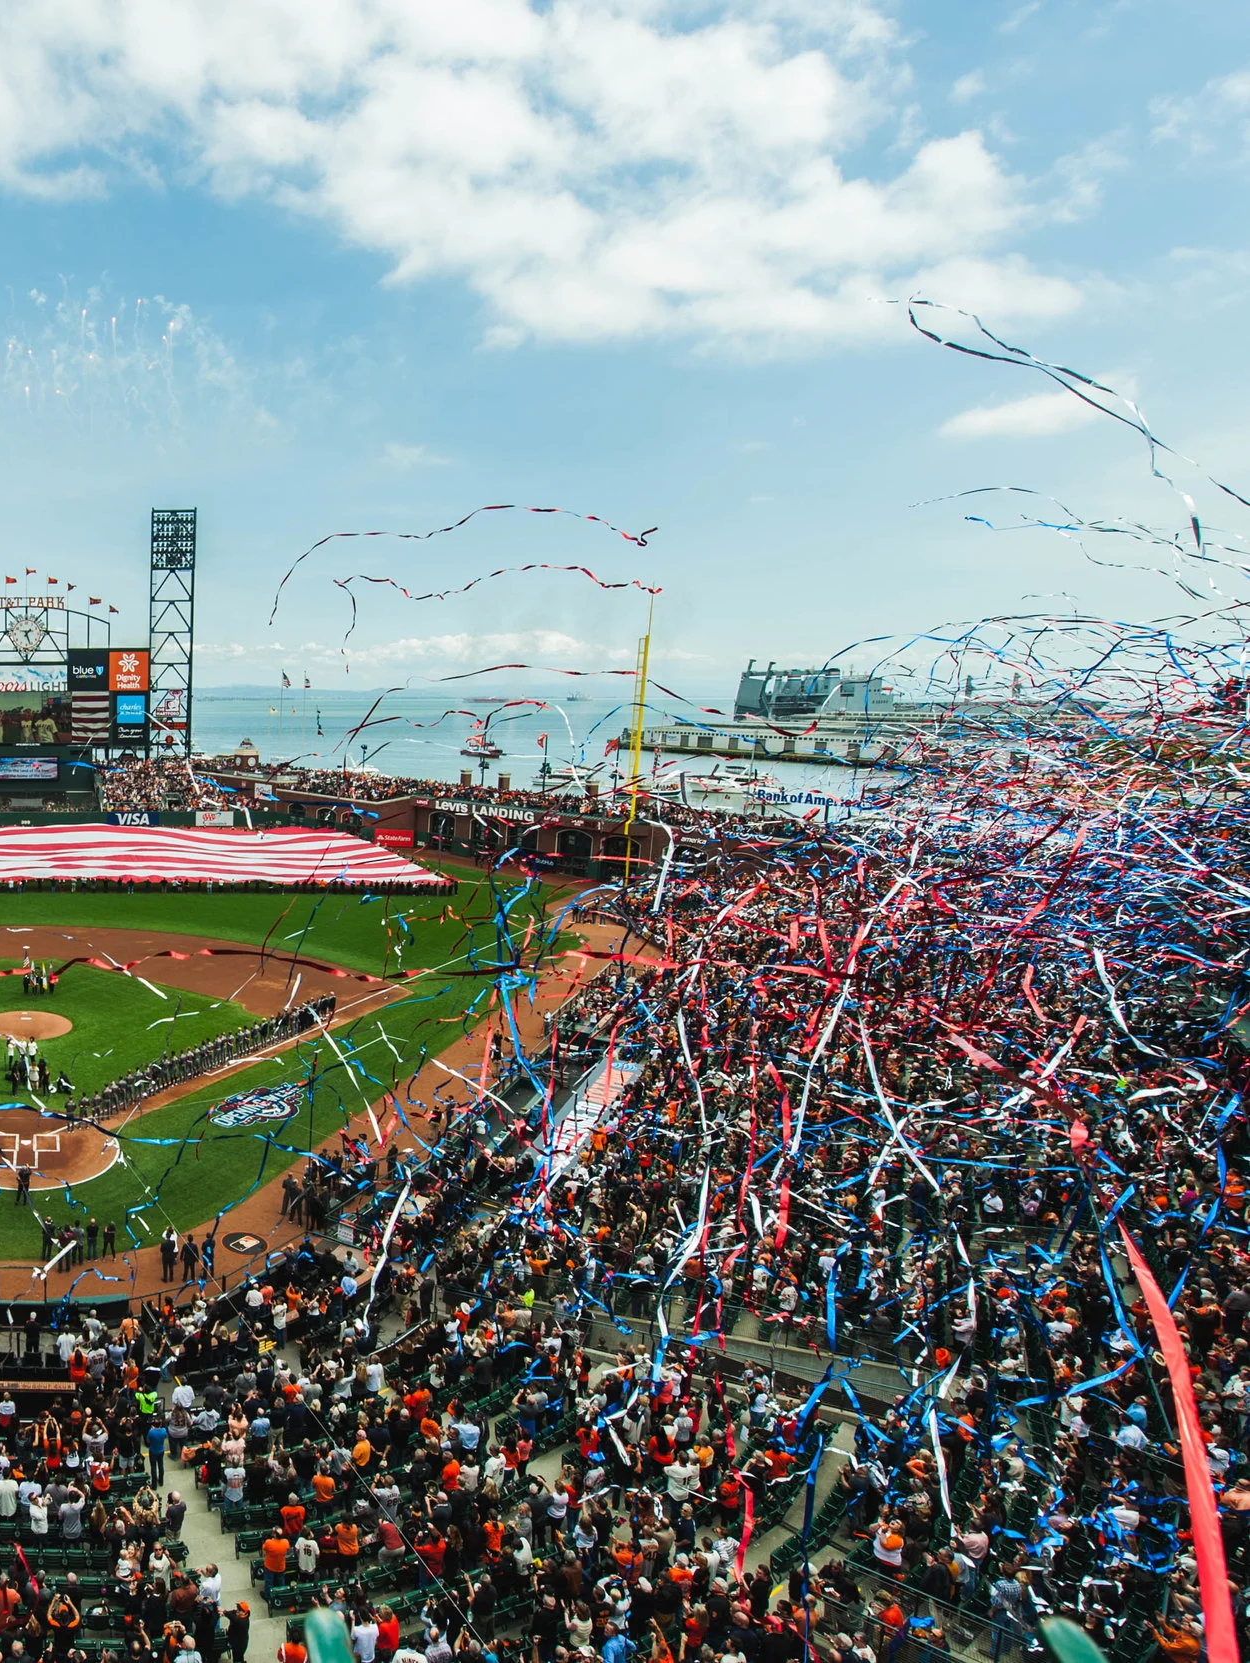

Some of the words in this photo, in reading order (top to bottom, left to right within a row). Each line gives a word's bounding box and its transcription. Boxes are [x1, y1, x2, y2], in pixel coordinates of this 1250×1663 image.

[28, 597, 65, 609] PARK
[72, 666, 94, 675] blue
[116, 674, 141, 682] Dignity
[30, 682, 68, 692] LIGHT
[757, 789, 790, 802] Bank
[790, 793, 803, 804] of
[472, 804, 535, 822] LANDING
[115, 813, 150, 825] VISA
[681, 836, 707, 845] america
